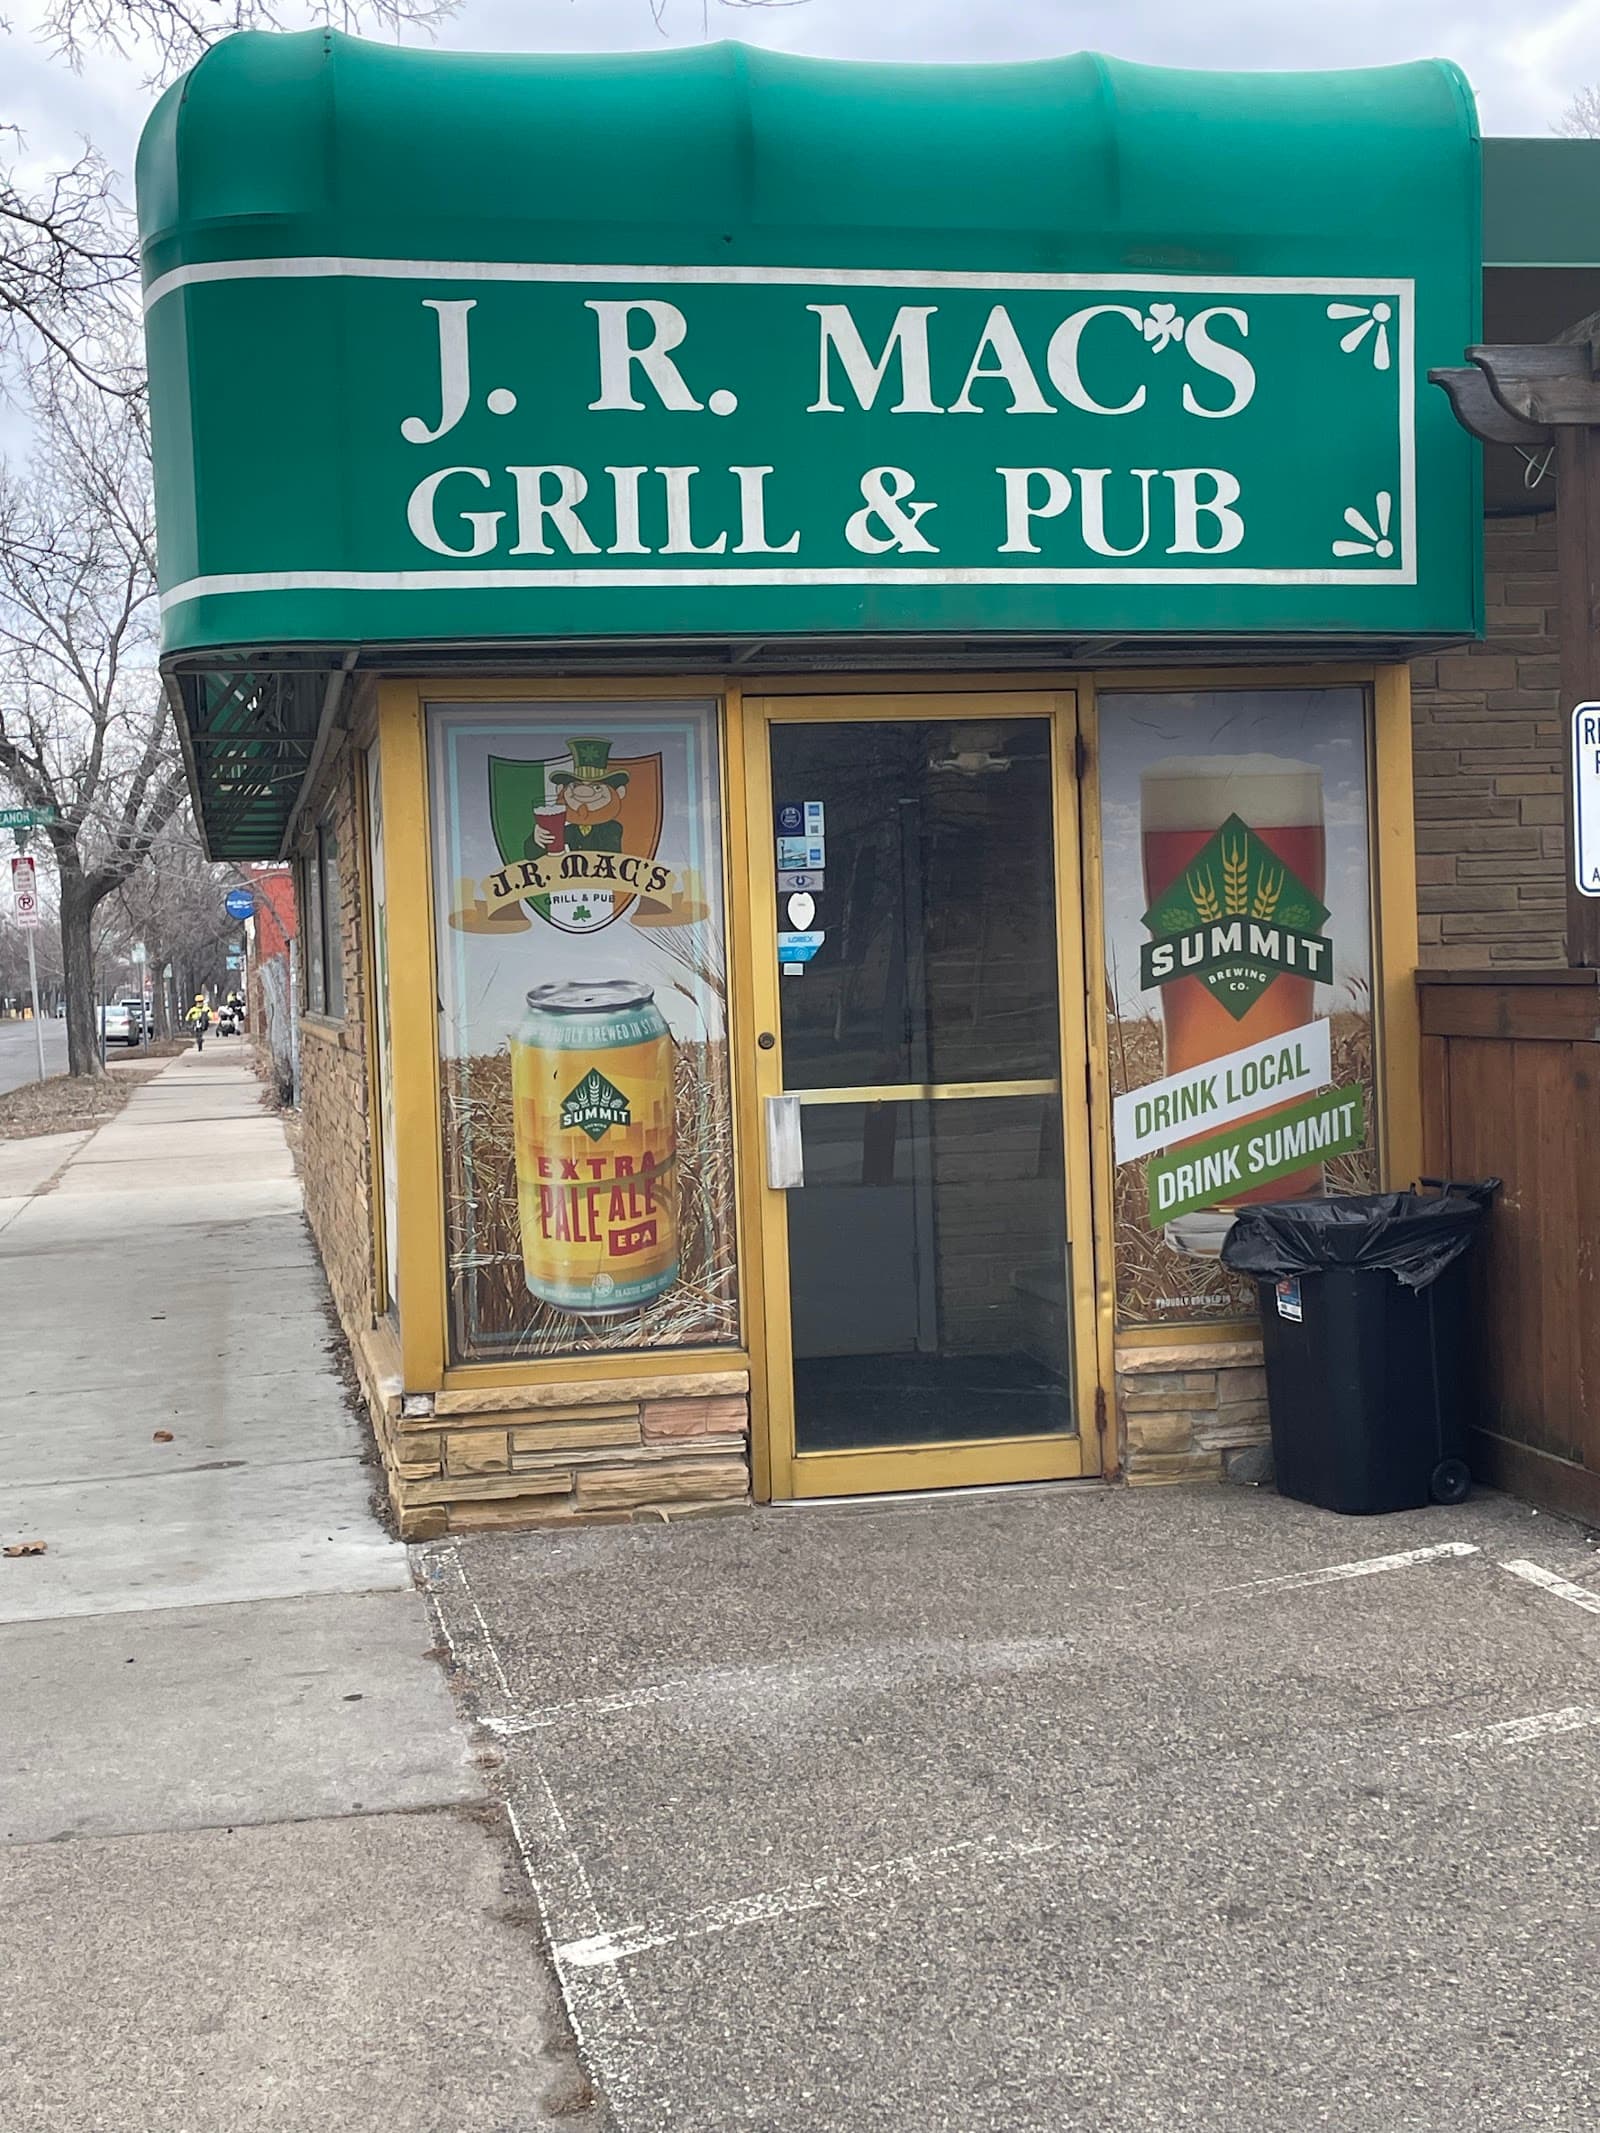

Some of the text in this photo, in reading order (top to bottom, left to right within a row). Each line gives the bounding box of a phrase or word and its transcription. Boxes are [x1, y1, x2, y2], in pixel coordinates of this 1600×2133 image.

[400, 299, 1257, 444] J. R. MAC'S
[407, 465, 1246, 557] GRILL & PUB
[559, 853, 672, 893] MAC'S
[544, 893, 616, 906] GRILL & PUB
[1151, 922, 1325, 978] SUMMIT
[1208, 967, 1268, 985] BREWING
[1229, 982, 1250, 991] CO.
[587, 1023, 629, 1043] BREWED
[1134, 1043, 1311, 1140] DRINK LOCAL
[563, 1107, 629, 1126] SUMMIT
[538, 1150, 656, 1180] EXTRA
[1158, 1101, 1357, 1211] DRINK SUMMIT
[540, 1180, 657, 1243] PALE ALE
[617, 1230, 652, 1248] EPA
